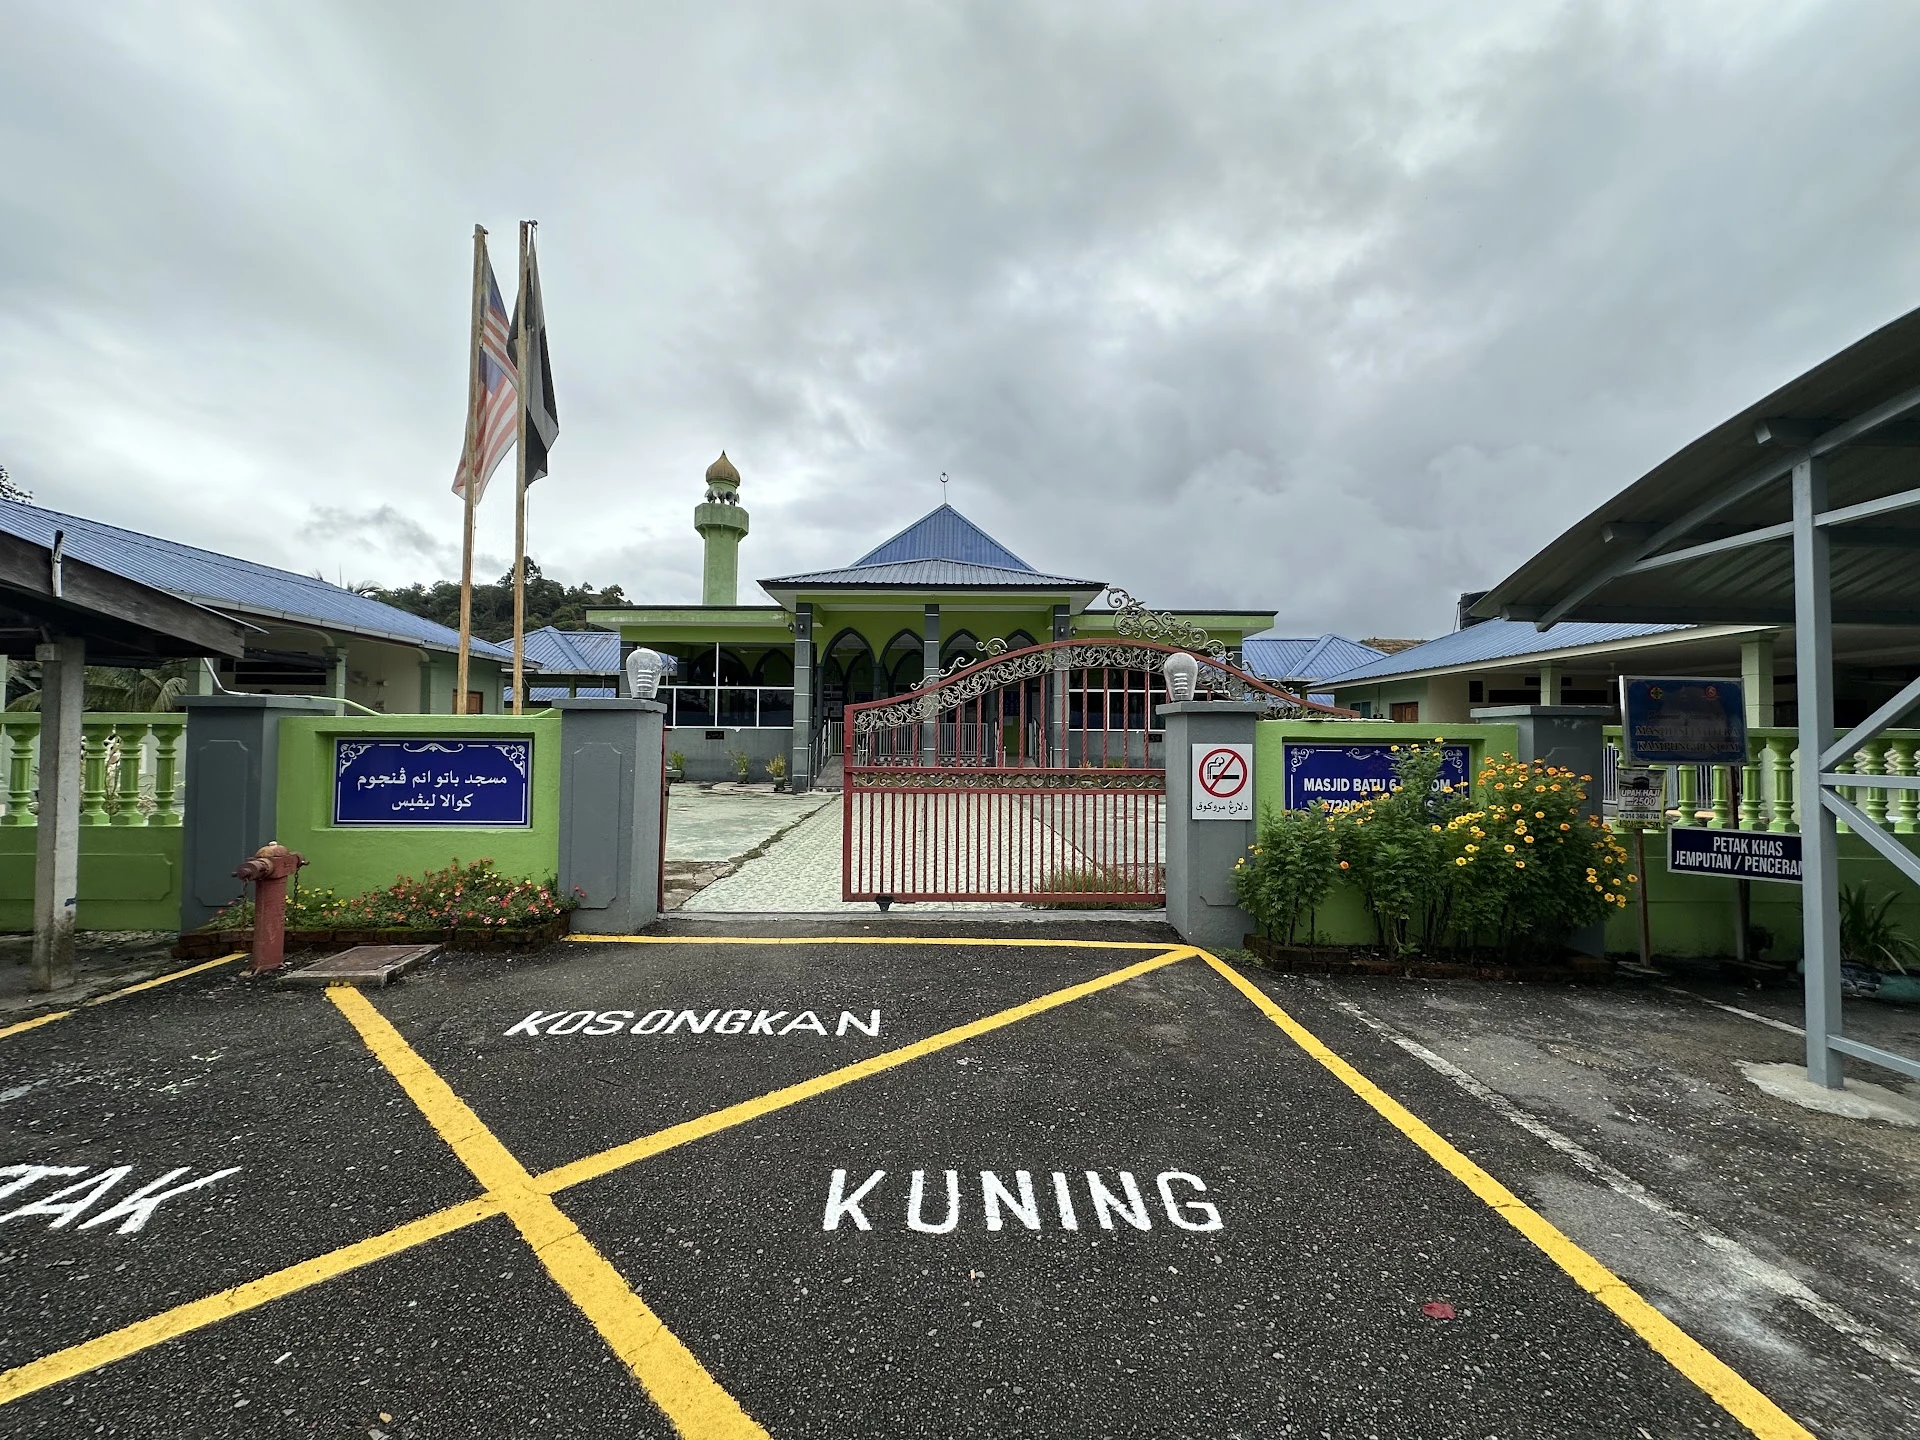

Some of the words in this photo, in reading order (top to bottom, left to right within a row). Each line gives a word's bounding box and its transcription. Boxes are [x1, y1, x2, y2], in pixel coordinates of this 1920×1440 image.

[1637, 741, 1695, 753] KAMPUNG
[412, 770, 431, 788] انم
[434, 770, 460, 788] باتو
[464, 771, 508, 785] مسجد
[1304, 778, 1350, 792] MASJID
[1353, 778, 1386, 792] BATU
[1713, 837, 1749, 854] PETAK
[1751, 839, 1783, 857] KHAS
[1675, 850, 1731, 870] JEMPUTAN
[1734, 855, 1742, 870] /
[504, 1008, 881, 1037] KOSONGKAN
[822, 1168, 1224, 1235] KUNING
